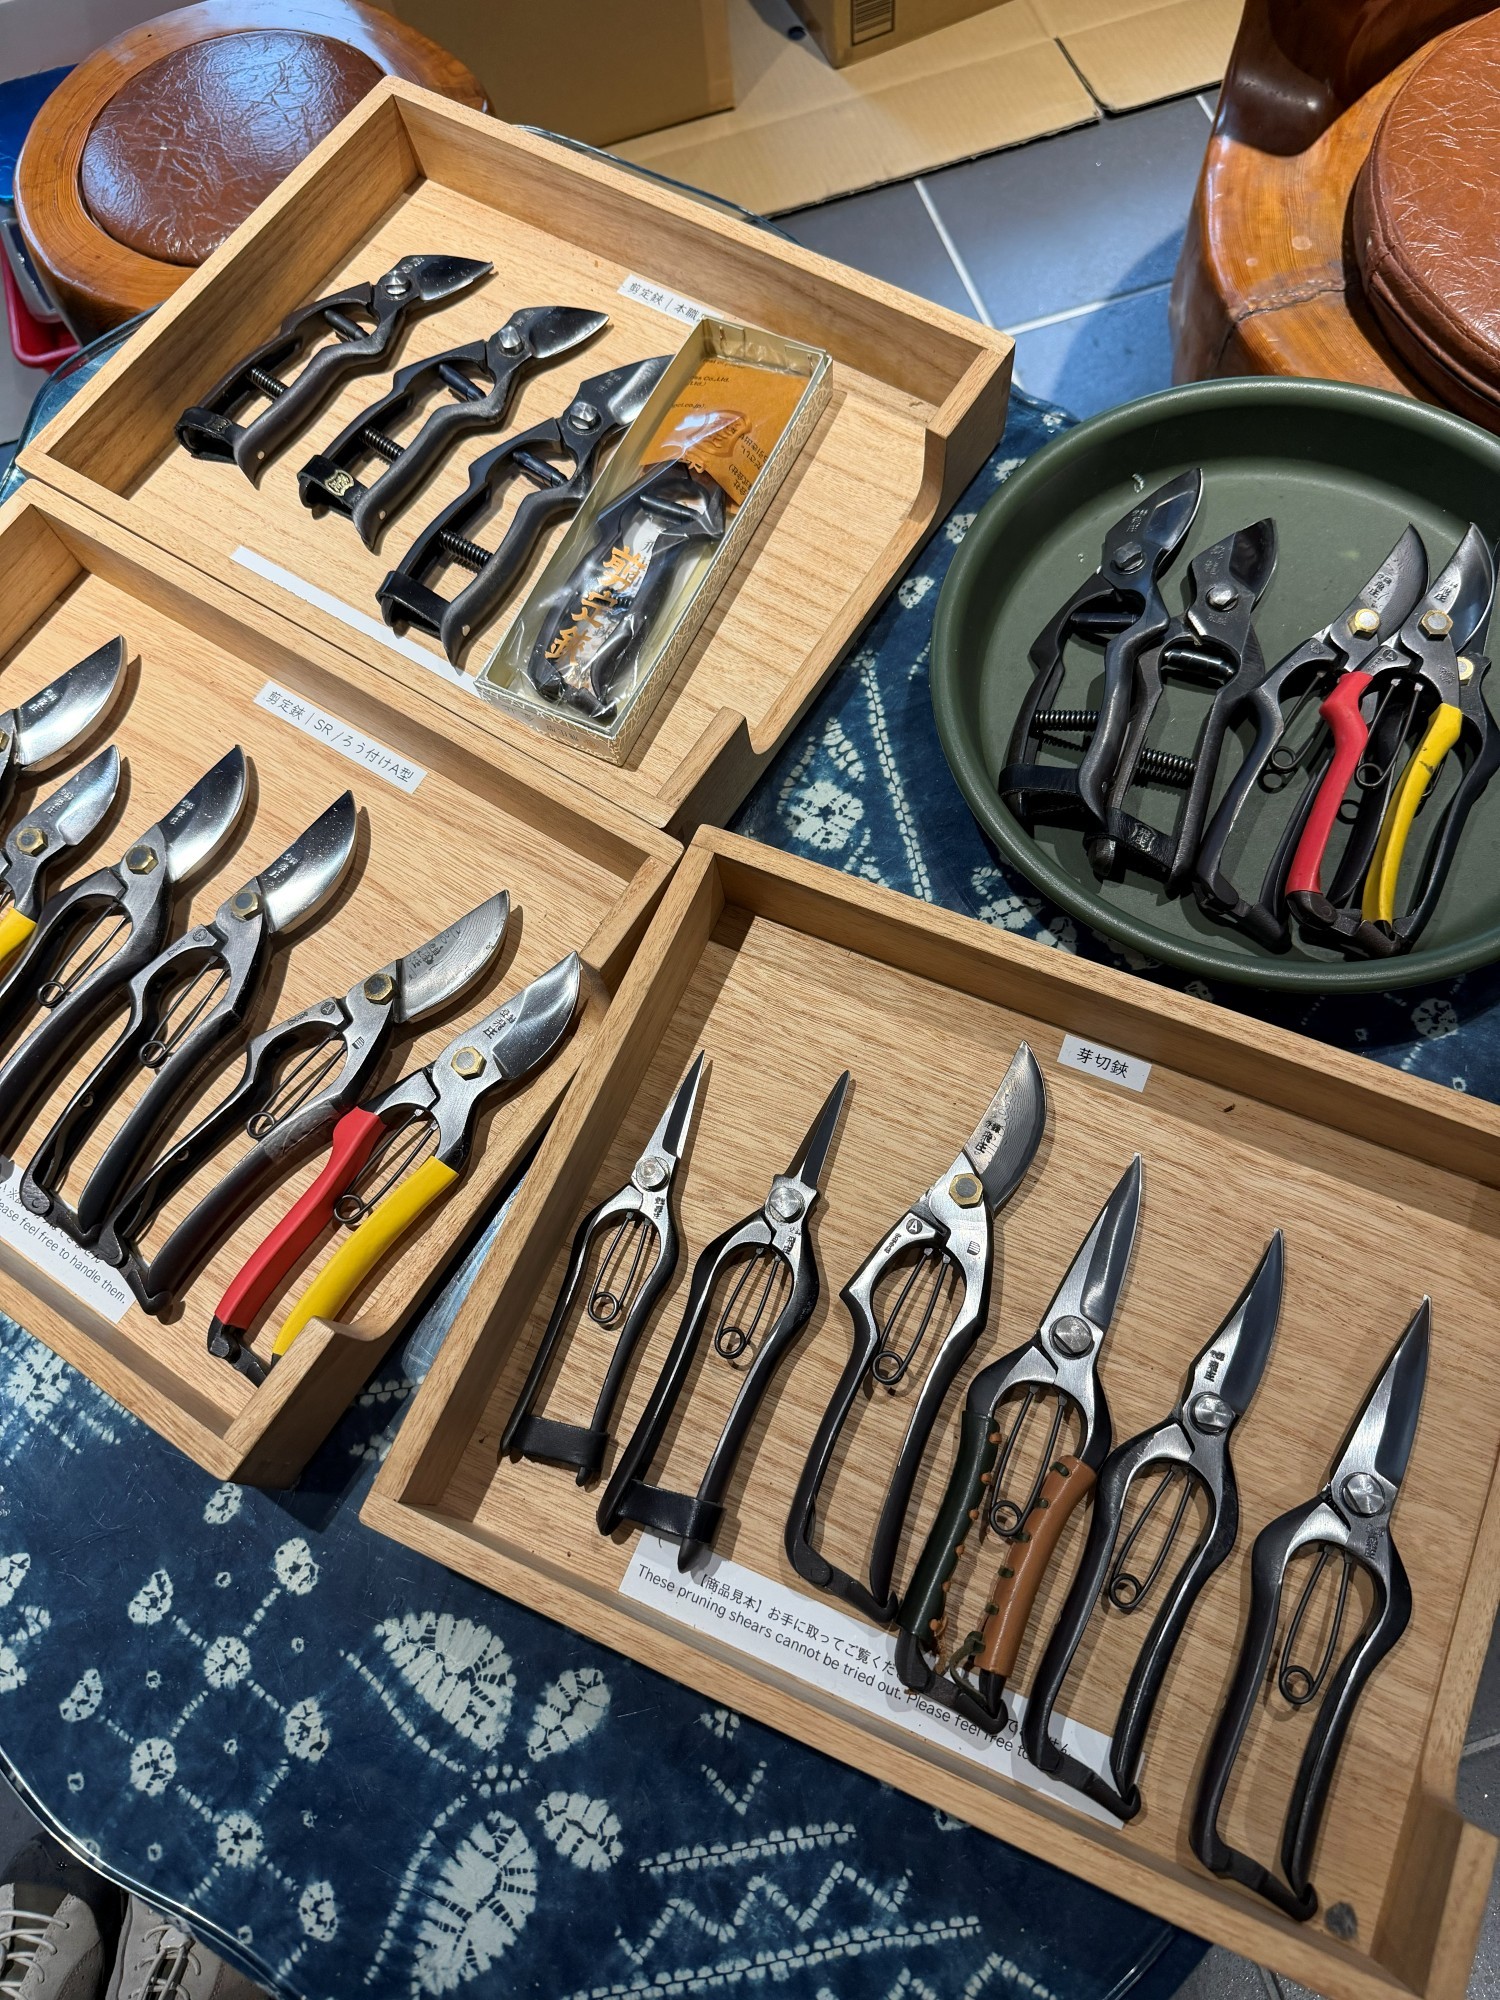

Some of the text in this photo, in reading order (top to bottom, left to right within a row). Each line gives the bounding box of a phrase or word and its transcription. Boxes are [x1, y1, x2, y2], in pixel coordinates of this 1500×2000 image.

[675, 304, 701, 322] 本職
[265, 691, 306, 721] 剪定鋏
[313, 718, 335, 737] SR
[1076, 1047, 1129, 1079] 芽切鋏
[0, 1198, 126, 1304] ease feel free to handle them.
[638, 1563, 676, 1593] These
[676, 1586, 727, 1619] pruning
[728, 1610, 773, 1639] shears
[774, 1632, 821, 1662] cannot
[822, 1651, 841, 1670] be
[842, 1661, 877, 1687] tried
[877, 1680, 902, 1701] out.
[906, 1693, 951, 1723] Please
[699, 1573, 902, 1678] 【商品見本】お手に取ってご覧くだ
